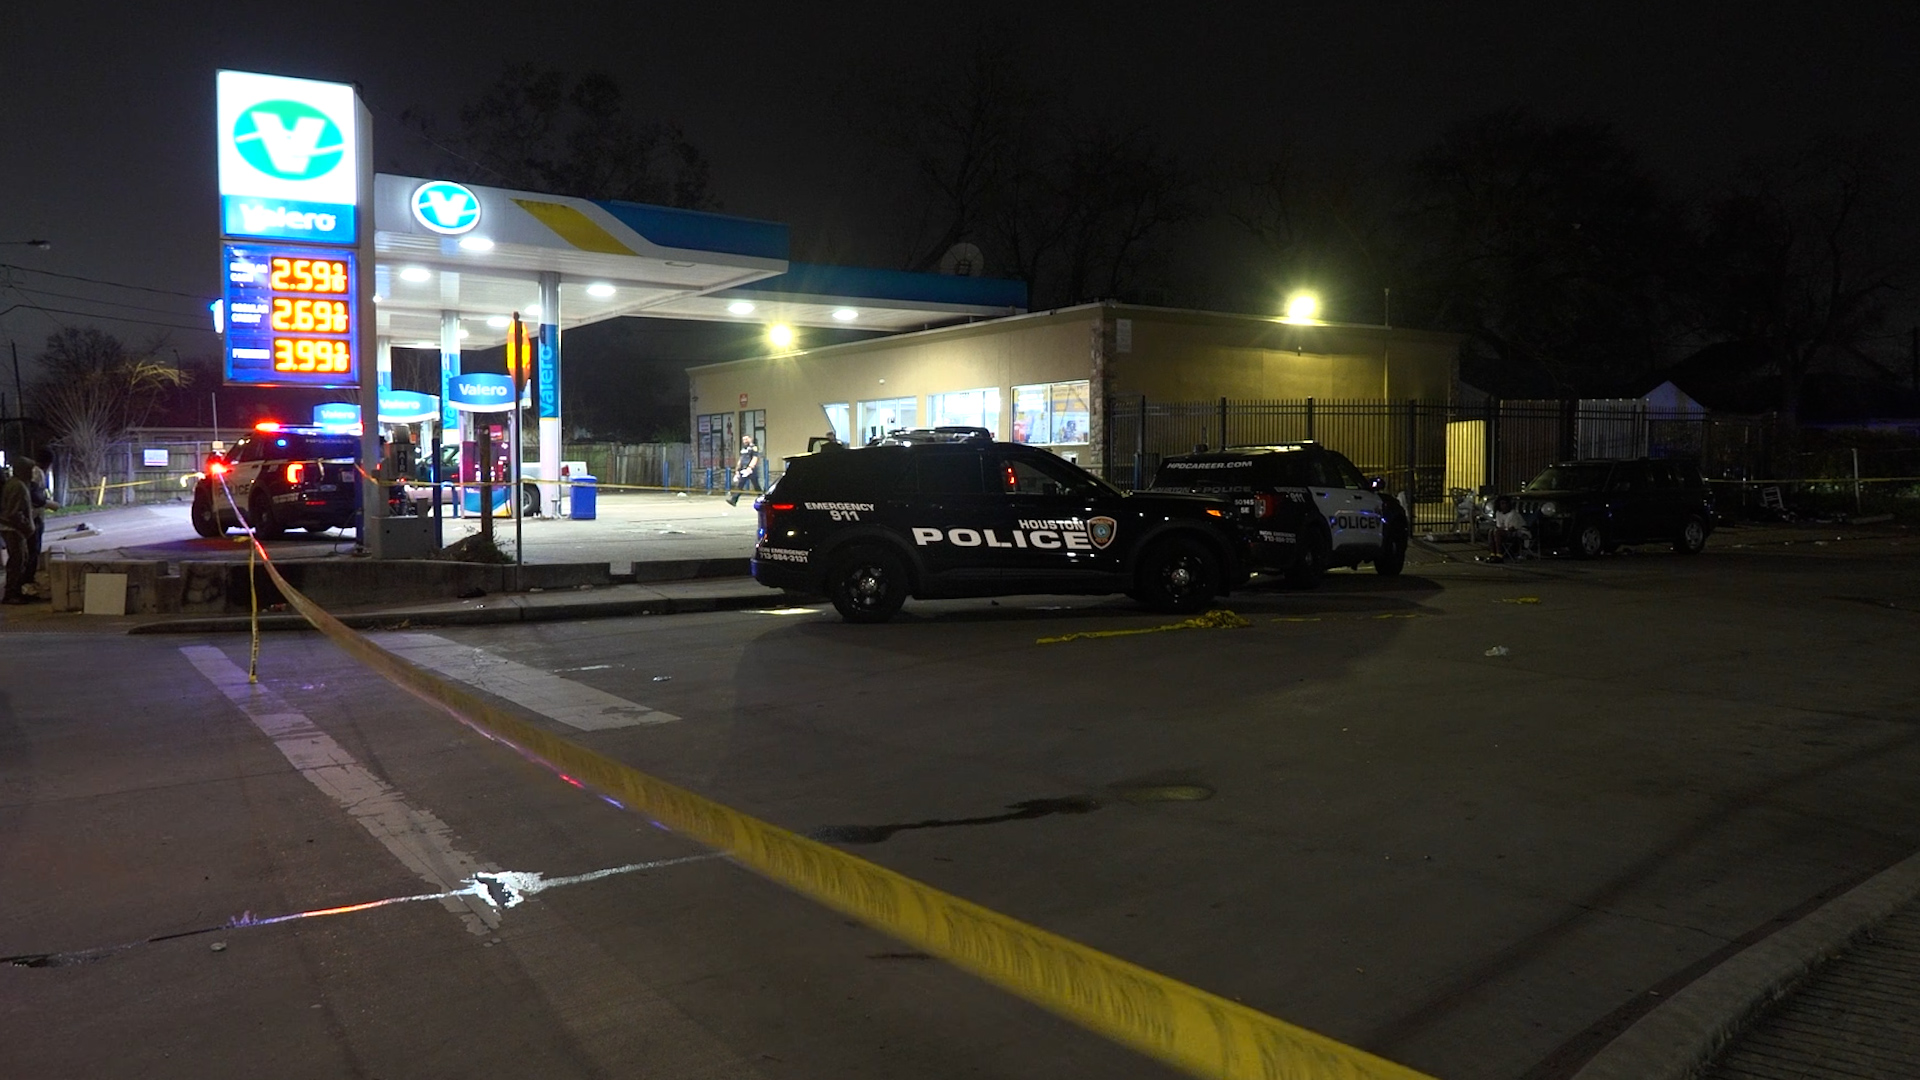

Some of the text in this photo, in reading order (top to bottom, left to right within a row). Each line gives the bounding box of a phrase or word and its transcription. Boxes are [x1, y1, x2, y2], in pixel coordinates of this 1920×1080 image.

[239, 203, 336, 232] Valero
[459, 383, 507, 396] Valero
[379, 399, 420, 409] Valero
[321, 410, 356, 419] Valero
[398, 451, 406, 471] AIR
[1166, 460, 1253, 470] HPDCAREER.COM
[1203, 486, 1252, 494] POLICE
[1289, 493, 1306, 503] 911
[804, 502, 875, 512] EMERGENCY
[829, 510, 861, 522] 911
[1018, 519, 1086, 531] HOUSTON
[1330, 516, 1376, 529] POLICE
[911, 527, 1093, 550] POLICE
[770, 547, 810, 556] EMERGENCY
